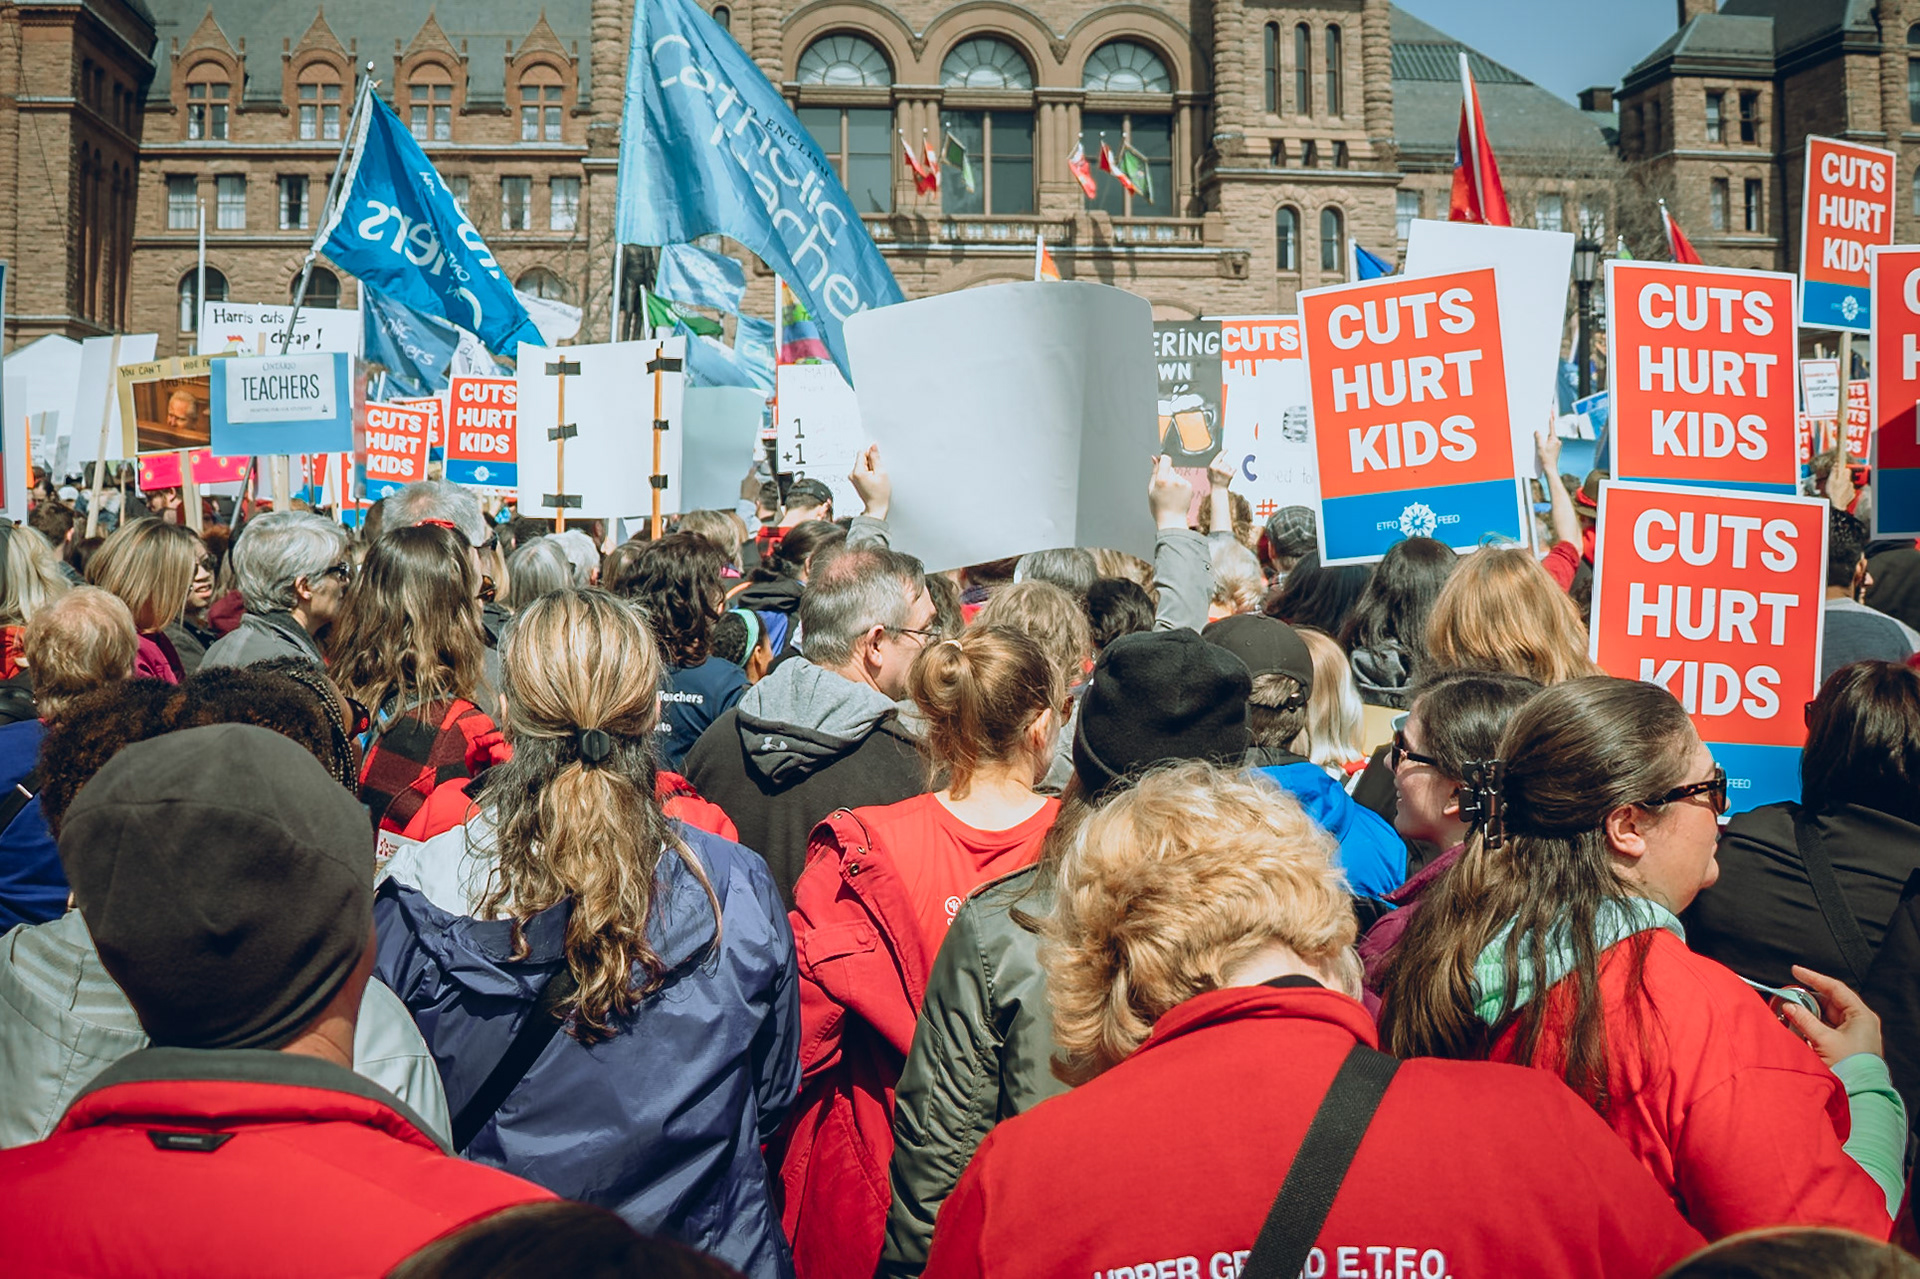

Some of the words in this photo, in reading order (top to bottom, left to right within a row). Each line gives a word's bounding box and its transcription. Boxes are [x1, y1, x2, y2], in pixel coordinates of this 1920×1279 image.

[1821, 152, 1886, 194] CUTS
[1818, 193, 1886, 234] HURT
[214, 308, 253, 324] Harris
[260, 311, 285, 324] cuts
[1328, 288, 1475, 350] CUTS
[1638, 283, 1774, 336] CUTS
[1221, 326, 1299, 352] CUTS
[1331, 349, 1483, 413] HURT
[1639, 346, 1778, 398] HURT
[241, 374, 320, 401] TEACHERS
[459, 383, 517, 404] CUTS
[367, 409, 422, 433] CUTS
[457, 407, 517, 429] HURT
[794, 418, 805, 439] 1
[365, 432, 421, 454] HURT
[459, 432, 510, 454] KIDS
[1348, 415, 1477, 473] KIDS
[1651, 410, 1768, 460] KIDS
[366, 454, 414, 476] KIDS
[1376, 520, 1399, 531] ETFO
[1633, 509, 1799, 572] CUTS
[1627, 582, 1799, 646] HURT
[657, 690, 704, 704] Teachers
[1639, 658, 1781, 719] KIDS
